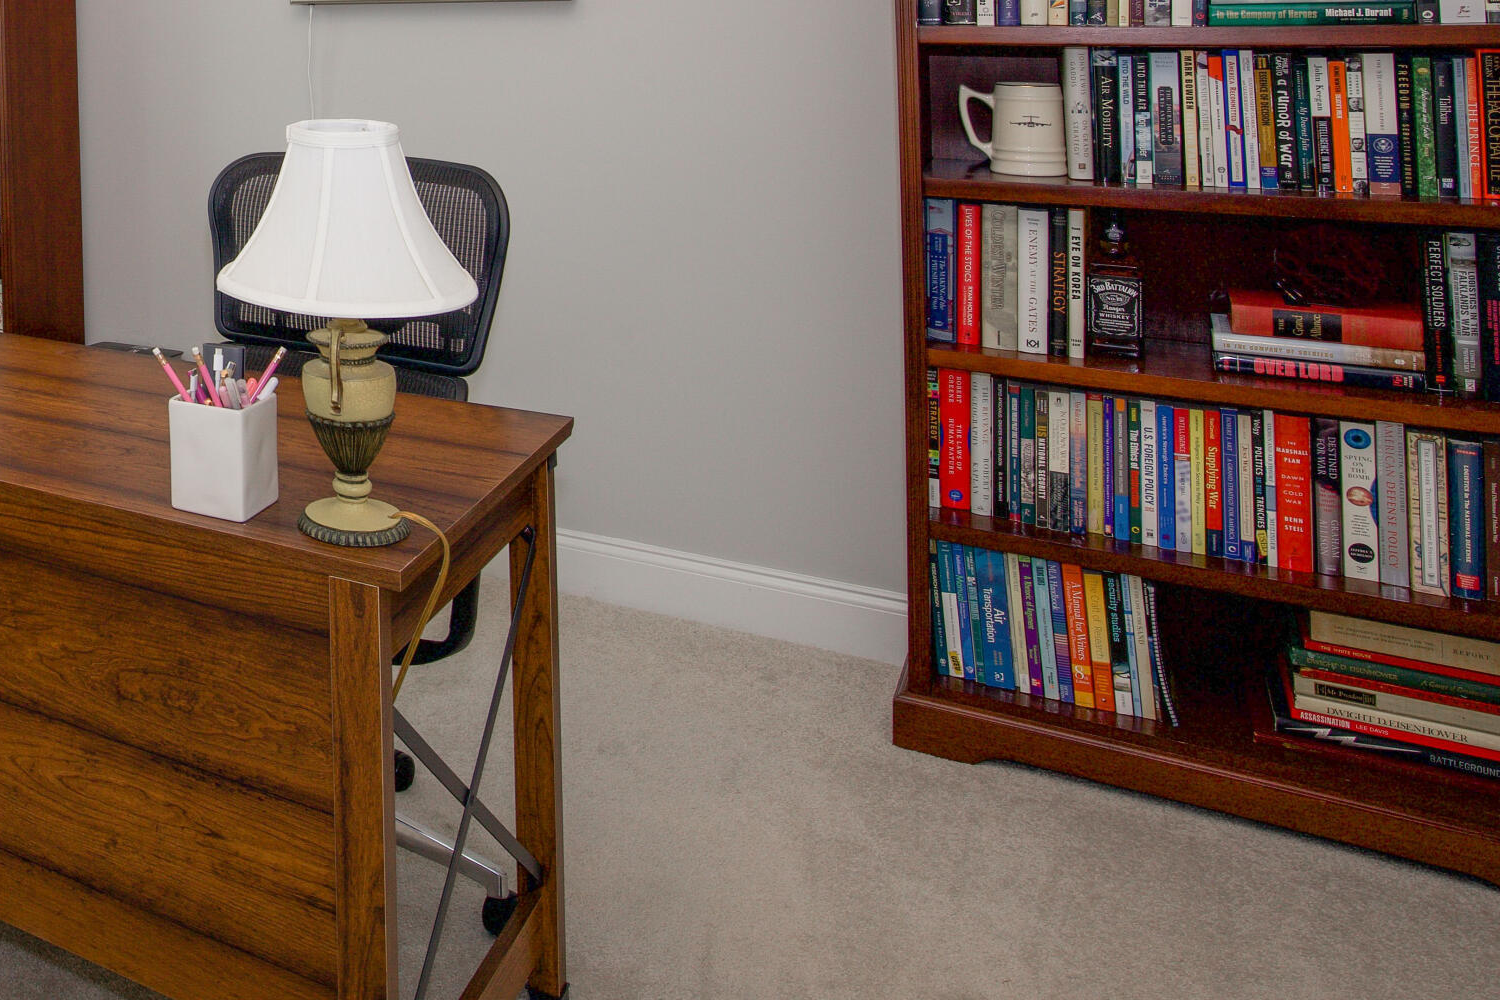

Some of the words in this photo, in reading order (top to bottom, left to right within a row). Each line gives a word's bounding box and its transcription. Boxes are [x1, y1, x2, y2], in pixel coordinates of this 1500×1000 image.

[1240, 10, 1276, 21] Company
[1324, 8, 1354, 17] Michael
[1364, 8, 1392, 17] Durant
[1137, 62, 1145, 78] INTO
[1184, 55, 1193, 77] MARK
[1227, 61, 1237, 85] AMERICA
[1314, 63, 1324, 82] John
[1101, 76, 1113, 95] AIR
[1137, 79, 1146, 95] THIN
[1184, 78, 1194, 110] BOWDEN
[1260, 71, 1269, 93] ESSENCE
[1397, 64, 1411, 109] FREEDOM
[1138, 98, 1147, 110] AIR
[1229, 86, 1238, 121] RECOMMITTED
[1260, 93, 1269, 101] OF
[1313, 84, 1325, 112] Keegan
[1439, 95, 1452, 125] Taliban
[1101, 98, 1114, 148] MOBILITY
[1261, 101, 1271, 126] DECISION
[1467, 102, 1478, 123] THE
[1278, 130, 1293, 141] of
[1300, 116, 1310, 137] Dearest
[1280, 143, 1293, 168] war
[1469, 126, 1480, 167] PRINCE
[965, 208, 973, 226] LIVES
[964, 228, 972, 239] OF
[1071, 235, 1080, 252] EYE
[964, 240, 972, 255] THE
[1029, 229, 1038, 266] ENEMY
[1071, 255, 1080, 267] ON
[1428, 240, 1443, 282] PERFECT
[964, 256, 972, 283] STOICS
[1053, 251, 1067, 314] STRATEGY
[990, 262, 1006, 310] WINTER
[1071, 271, 1081, 300] KOREA
[1458, 270, 1470, 315] FALKLANDS
[1468, 271, 1478, 309] LOGISTICS
[1029, 297, 1038, 333] GATES
[1099, 312, 1130, 320] WHISKEY
[1431, 285, 1446, 327] SOLDIERS
[1461, 319, 1471, 336] WAR
[1470, 323, 1479, 336] THE
[929, 400, 938, 440] STRATEGY
[1143, 427, 1153, 442] U.S.
[1316, 438, 1326, 456] FOR
[1038, 437, 1046, 467] NATIONAL
[1130, 441, 1139, 460] Ethics
[1144, 443, 1154, 476] FOREIGN
[1254, 446, 1263, 475] POLITICS
[1275, 447, 1308, 456] MARSHALL
[1327, 436, 1338, 480] DESTINED
[1383, 422, 1395, 477] AMERICAN
[1206, 446, 1218, 489] Supplying
[1317, 456, 1327, 475] WAR
[1038, 469, 1046, 500] SECURITY
[1145, 478, 1155, 505] POLICY
[1208, 490, 1219, 508] War
[1256, 495, 1265, 528] TRENCHES
[1386, 481, 1397, 526] DEFENSE
[1284, 516, 1304, 524] BENN
[1284, 525, 1304, 533] STEIL
[1330, 519, 1341, 559] GRAHAM
[1387, 531, 1399, 569] POLICY
[1049, 580, 1061, 610] Handbook
[1071, 590, 1085, 620] Manual
[1090, 594, 1100, 613] Craft
[1106, 577, 1119, 611] security
[982, 587, 997, 643] Transportation
[992, 607, 1006, 625] Air
[1075, 620, 1084, 632] for
[1110, 612, 1122, 643] studies
[1077, 633, 1087, 661] Writers
[1094, 625, 1104, 659] Research
[1452, 647, 1491, 661] REPORT
[1300, 711, 1351, 730] ASSASSINATION
[1369, 726, 1390, 736] DAVIS
[1326, 706, 1377, 724] DWIGHT
[1386, 717, 1470, 743] EISENHOWER
